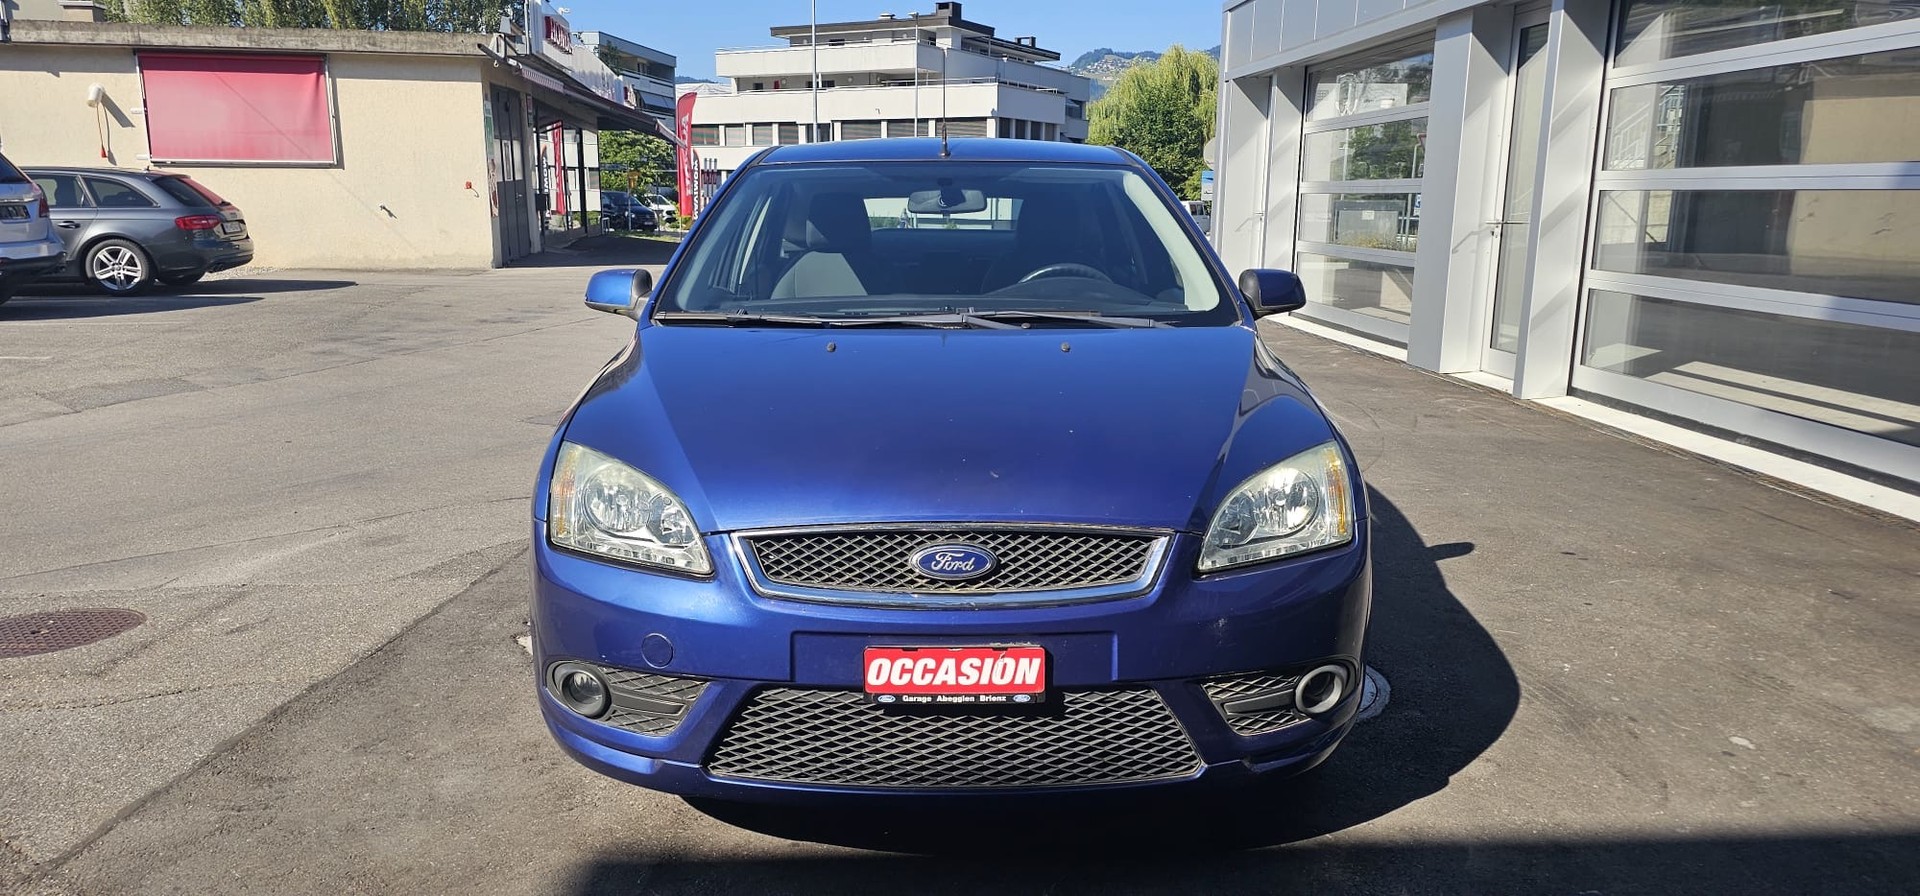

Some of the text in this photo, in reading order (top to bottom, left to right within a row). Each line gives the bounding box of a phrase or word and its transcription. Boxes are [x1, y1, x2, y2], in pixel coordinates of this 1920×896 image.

[931, 552, 975, 571] Ford
[867, 657, 1041, 686] OCCASION
[902, 695, 932, 703] Garage
[980, 694, 1007, 702] Brienz
